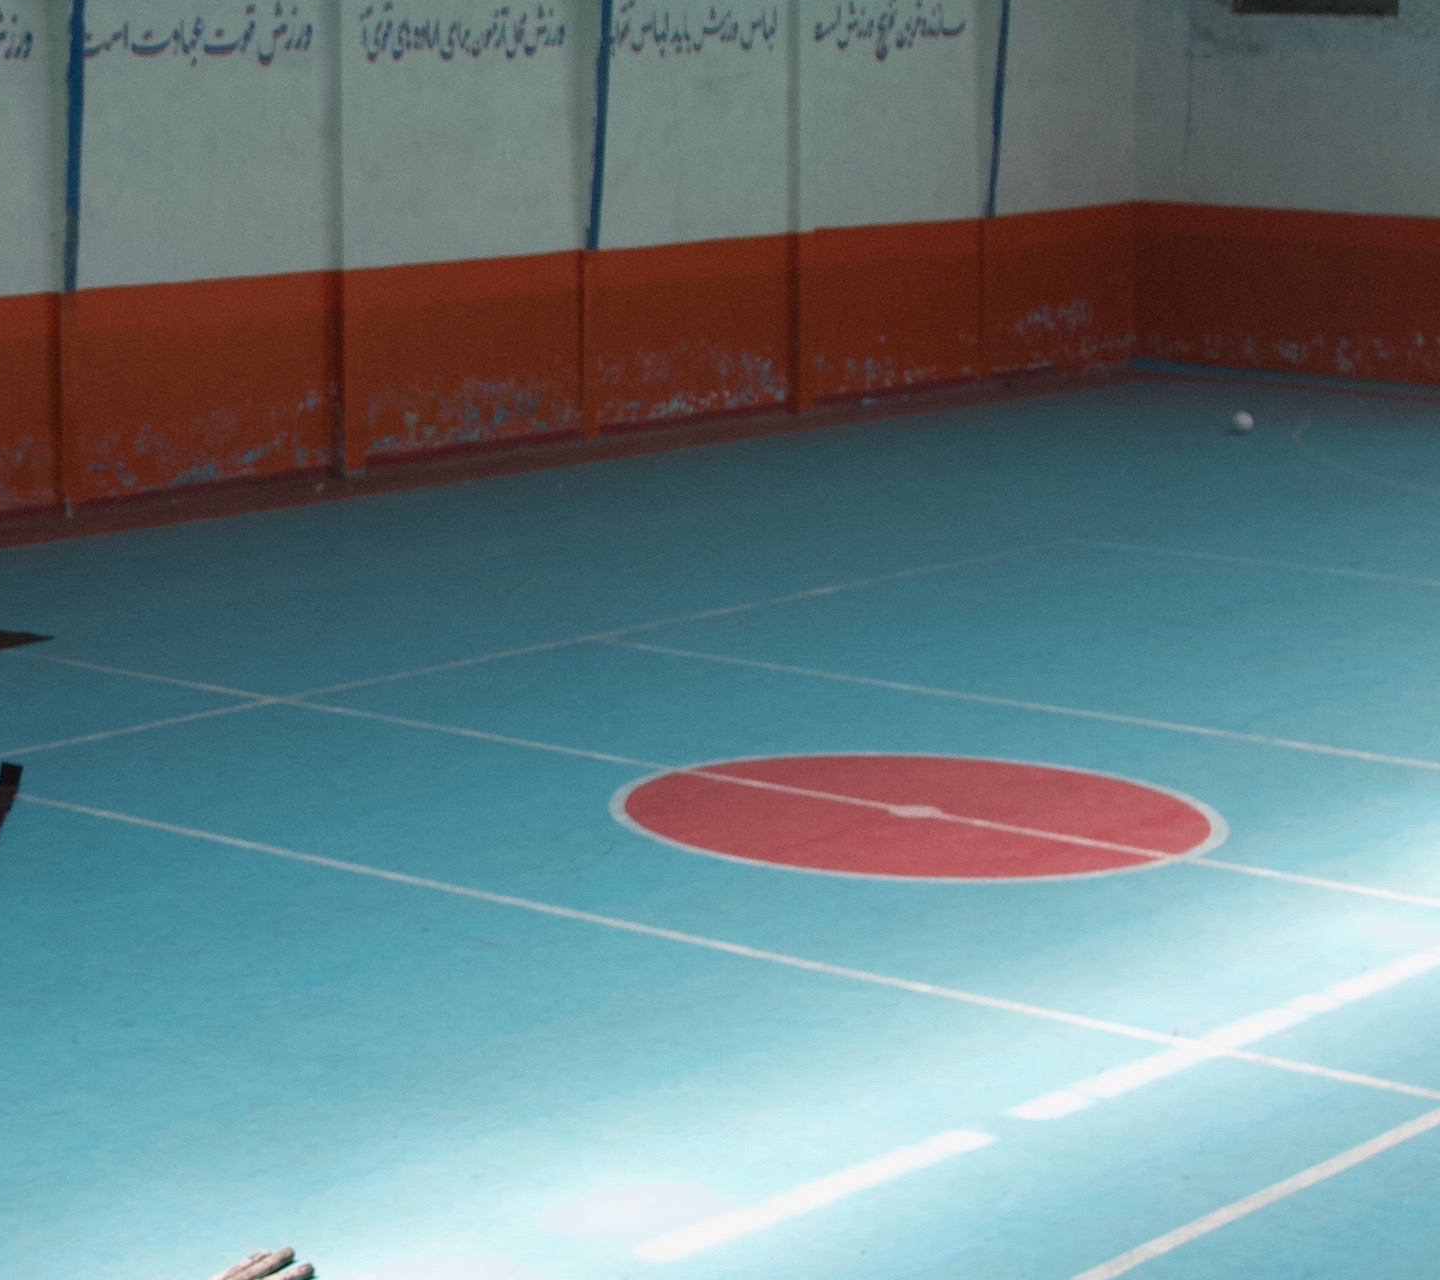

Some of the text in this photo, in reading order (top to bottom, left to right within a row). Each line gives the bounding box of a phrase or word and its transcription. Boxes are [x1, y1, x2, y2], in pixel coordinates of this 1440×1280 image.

[83, 21, 128, 58] است
[259, 0, 313, 66] ورزش
[836, 0, 876, 51] ورزش
